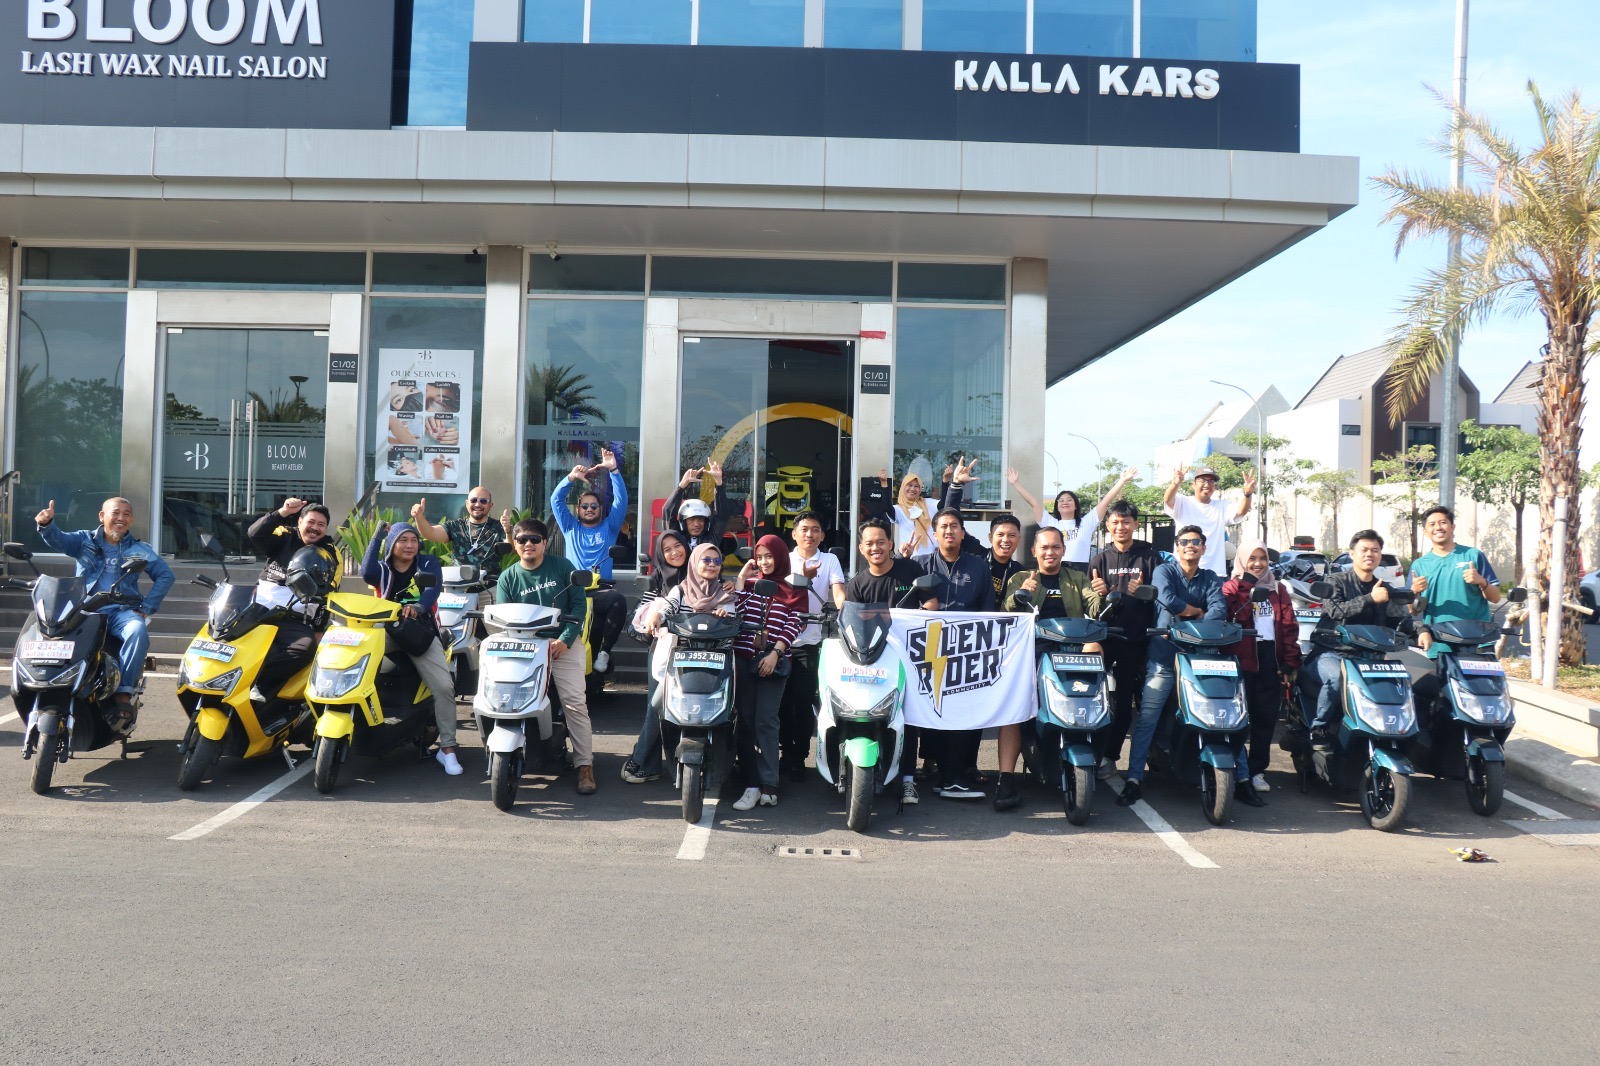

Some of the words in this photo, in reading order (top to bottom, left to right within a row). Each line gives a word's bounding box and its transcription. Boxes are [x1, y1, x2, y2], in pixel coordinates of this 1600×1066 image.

[26, 0, 324, 46] BLOOM
[21, 50, 94, 76] LASH
[99, 53, 162, 77] WAX
[167, 54, 234, 78] NAIL
[237, 55, 328, 80] SALON
[954, 60, 1081, 95] KALLA
[1099, 64, 1221, 99] KARS
[331, 360, 356, 369] C1/02
[390, 369, 411, 377] OUR
[413, 371, 456, 379] SERVICES
[267, 444, 307, 459] BLOOM
[271, 463, 287, 471] BEAUTY
[287, 463, 304, 471] ATELIER
[909, 617, 1015, 663] SILENT
[675, 652, 686, 660] DD
[688, 652, 707, 660] 3952
[1065, 656, 1084, 664] 2244
[915, 648, 1000, 694] RIDER
[1358, 663, 1371, 671] DD
[946, 682, 987, 695] COMMUNITY
